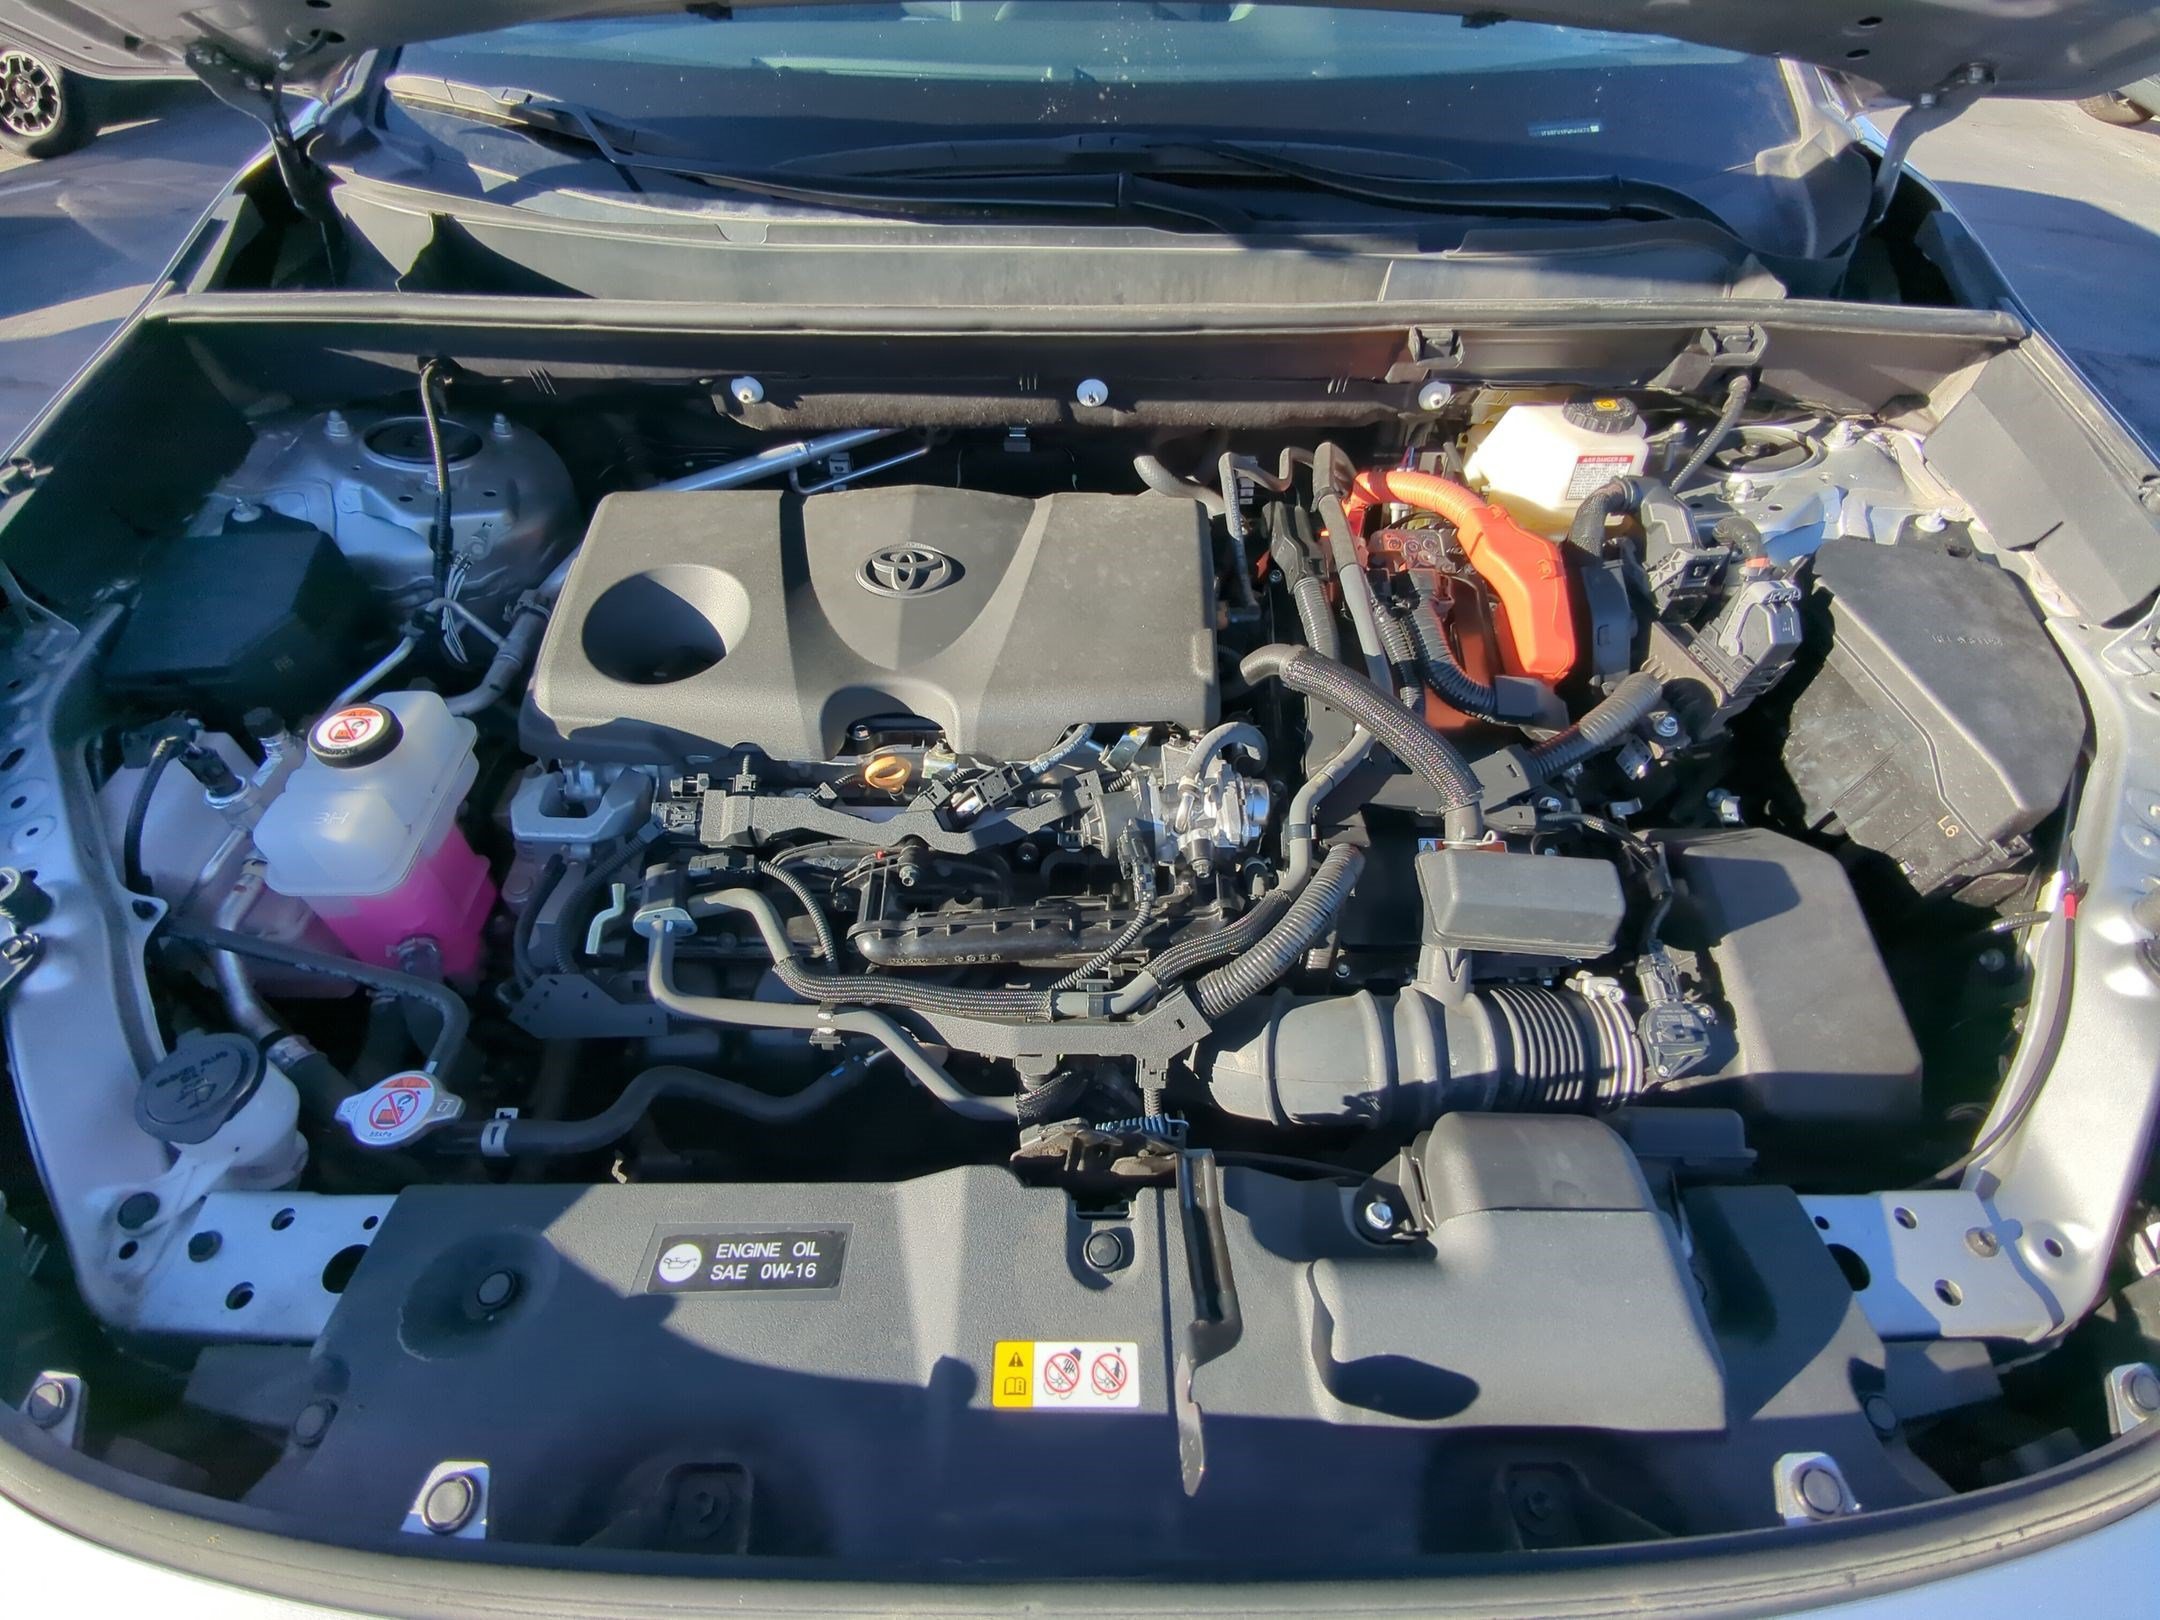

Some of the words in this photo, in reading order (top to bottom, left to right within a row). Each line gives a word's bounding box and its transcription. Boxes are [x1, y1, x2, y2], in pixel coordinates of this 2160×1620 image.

[1937, 814, 1959, 837] L6
[715, 1242, 782, 1259] ENGINE
[792, 1241, 821, 1257] OIL
[710, 1264, 749, 1280] SAE
[760, 1262, 817, 1279] 0W-16
